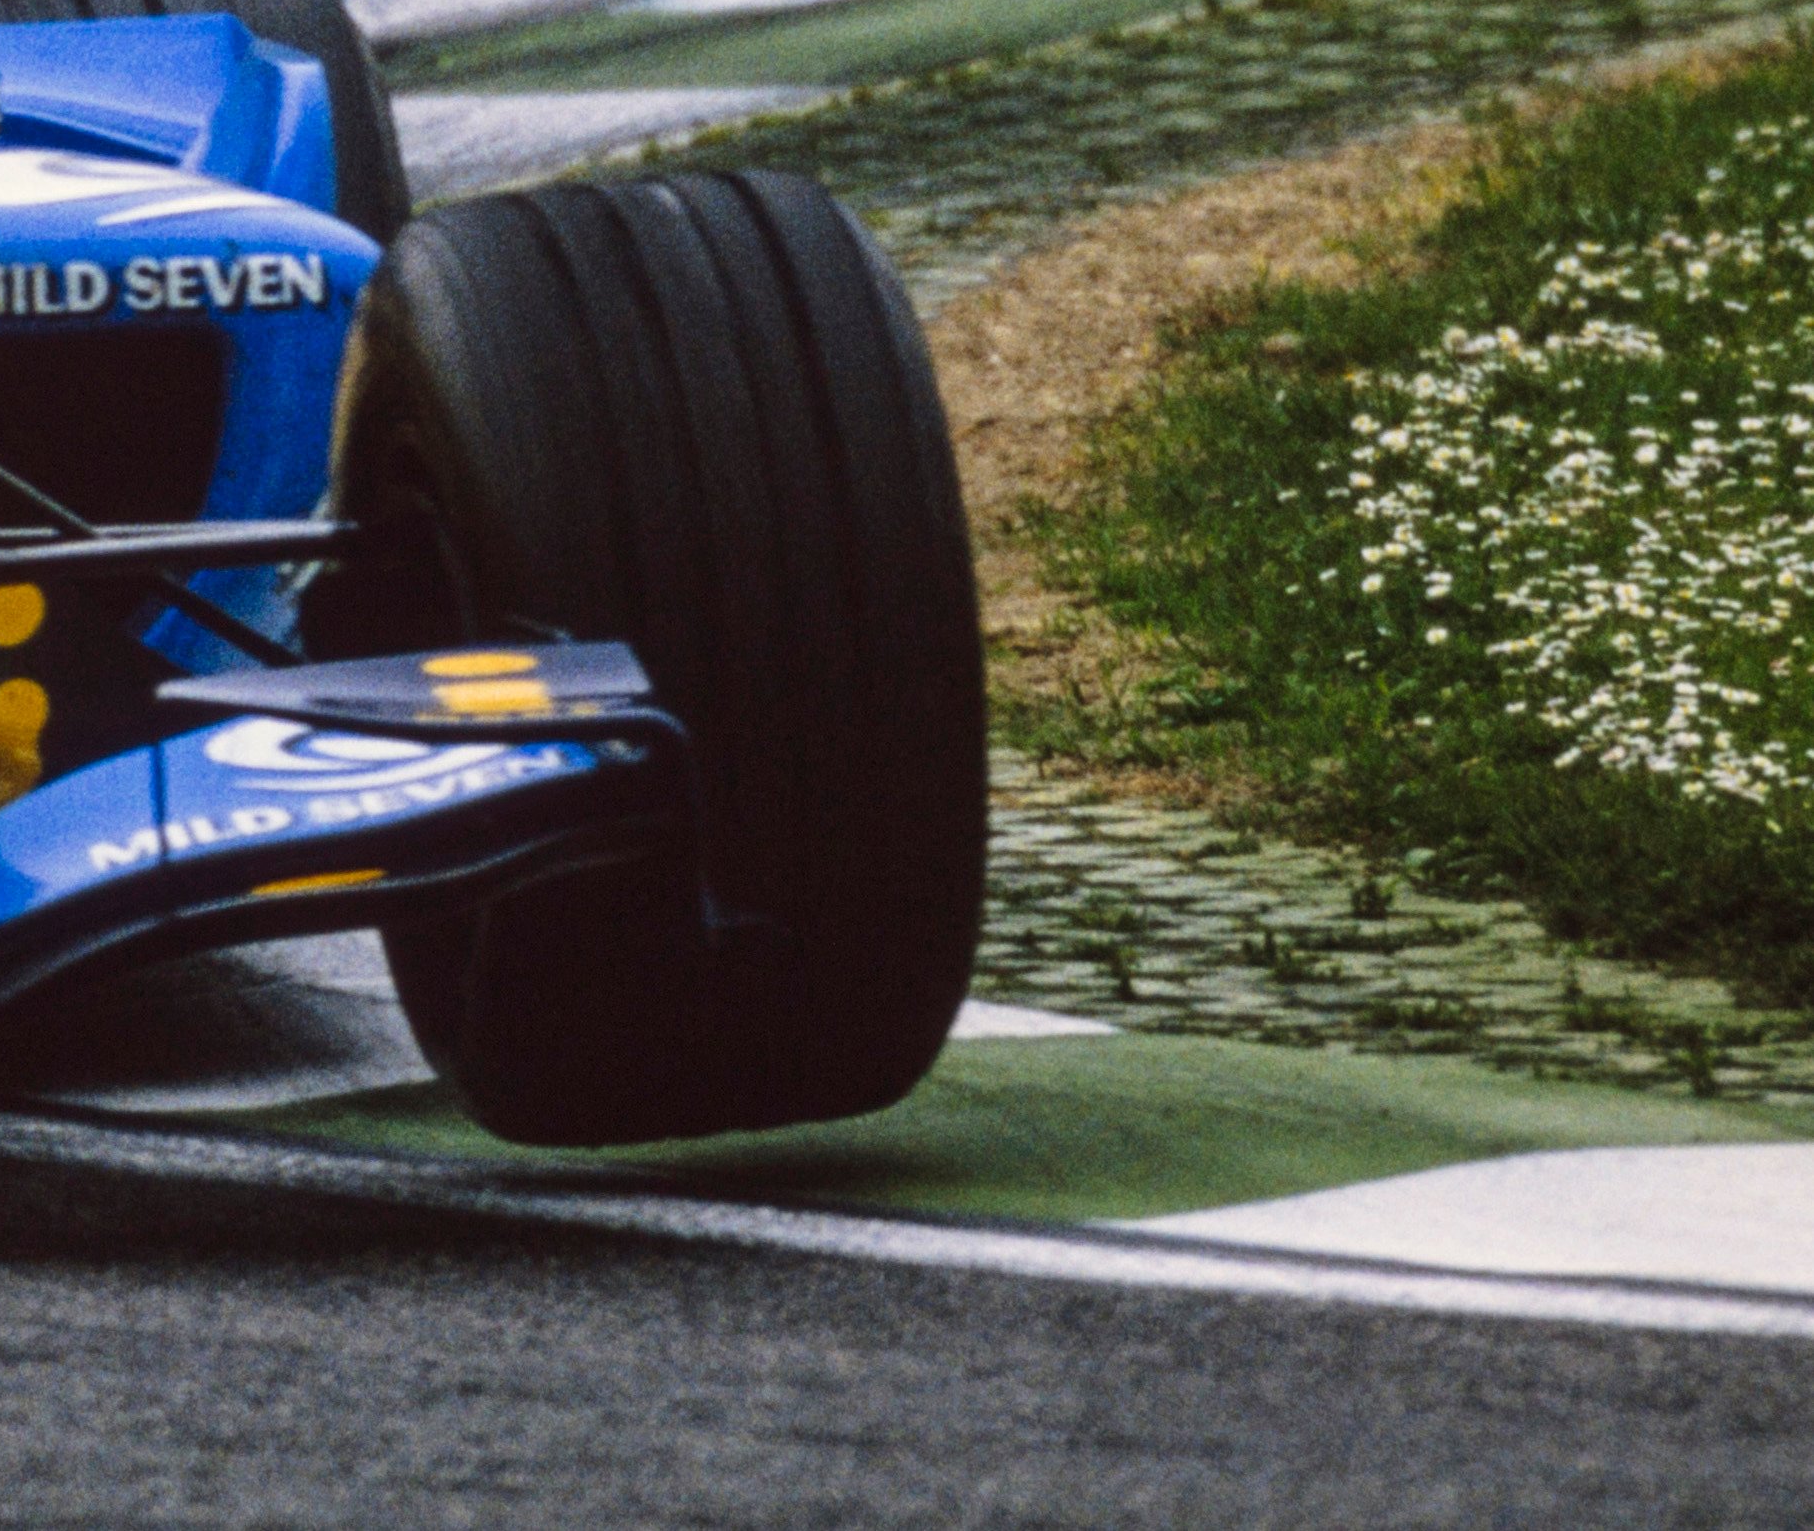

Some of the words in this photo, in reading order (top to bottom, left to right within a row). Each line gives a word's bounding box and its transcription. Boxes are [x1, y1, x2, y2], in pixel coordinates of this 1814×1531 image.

[123, 254, 325, 311] SEVEN
[89, 806, 292, 870] MILD
[306, 748, 565, 824] SEVEN
